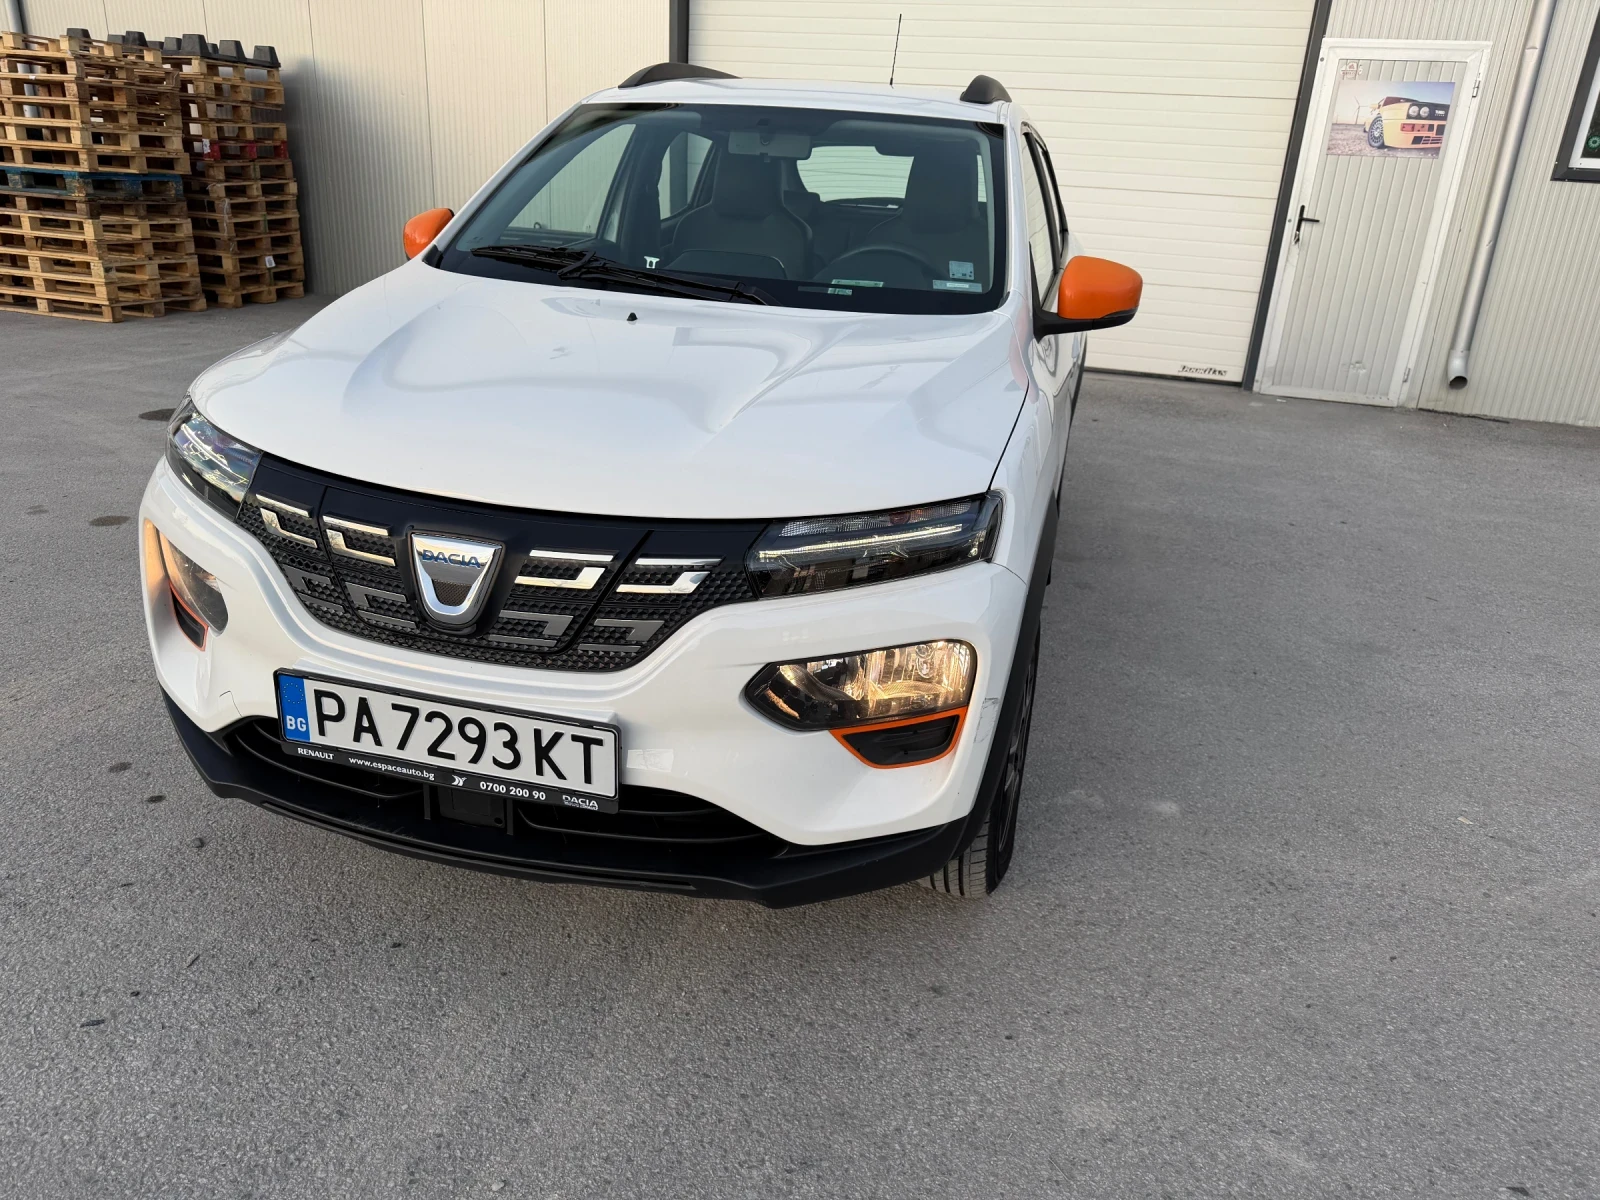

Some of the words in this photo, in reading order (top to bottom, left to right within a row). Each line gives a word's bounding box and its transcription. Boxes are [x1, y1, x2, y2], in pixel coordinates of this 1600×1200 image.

[422, 549, 481, 569] DACIA
[286, 715, 307, 732] BG
[297, 747, 334, 760] RENAULT
[348, 757, 435, 781] www.espaceauto.bg
[480, 781, 506, 793] 0700
[509, 786, 529, 797] 200
[532, 791, 546, 800] 90
[562, 795, 598, 808] DACIA
